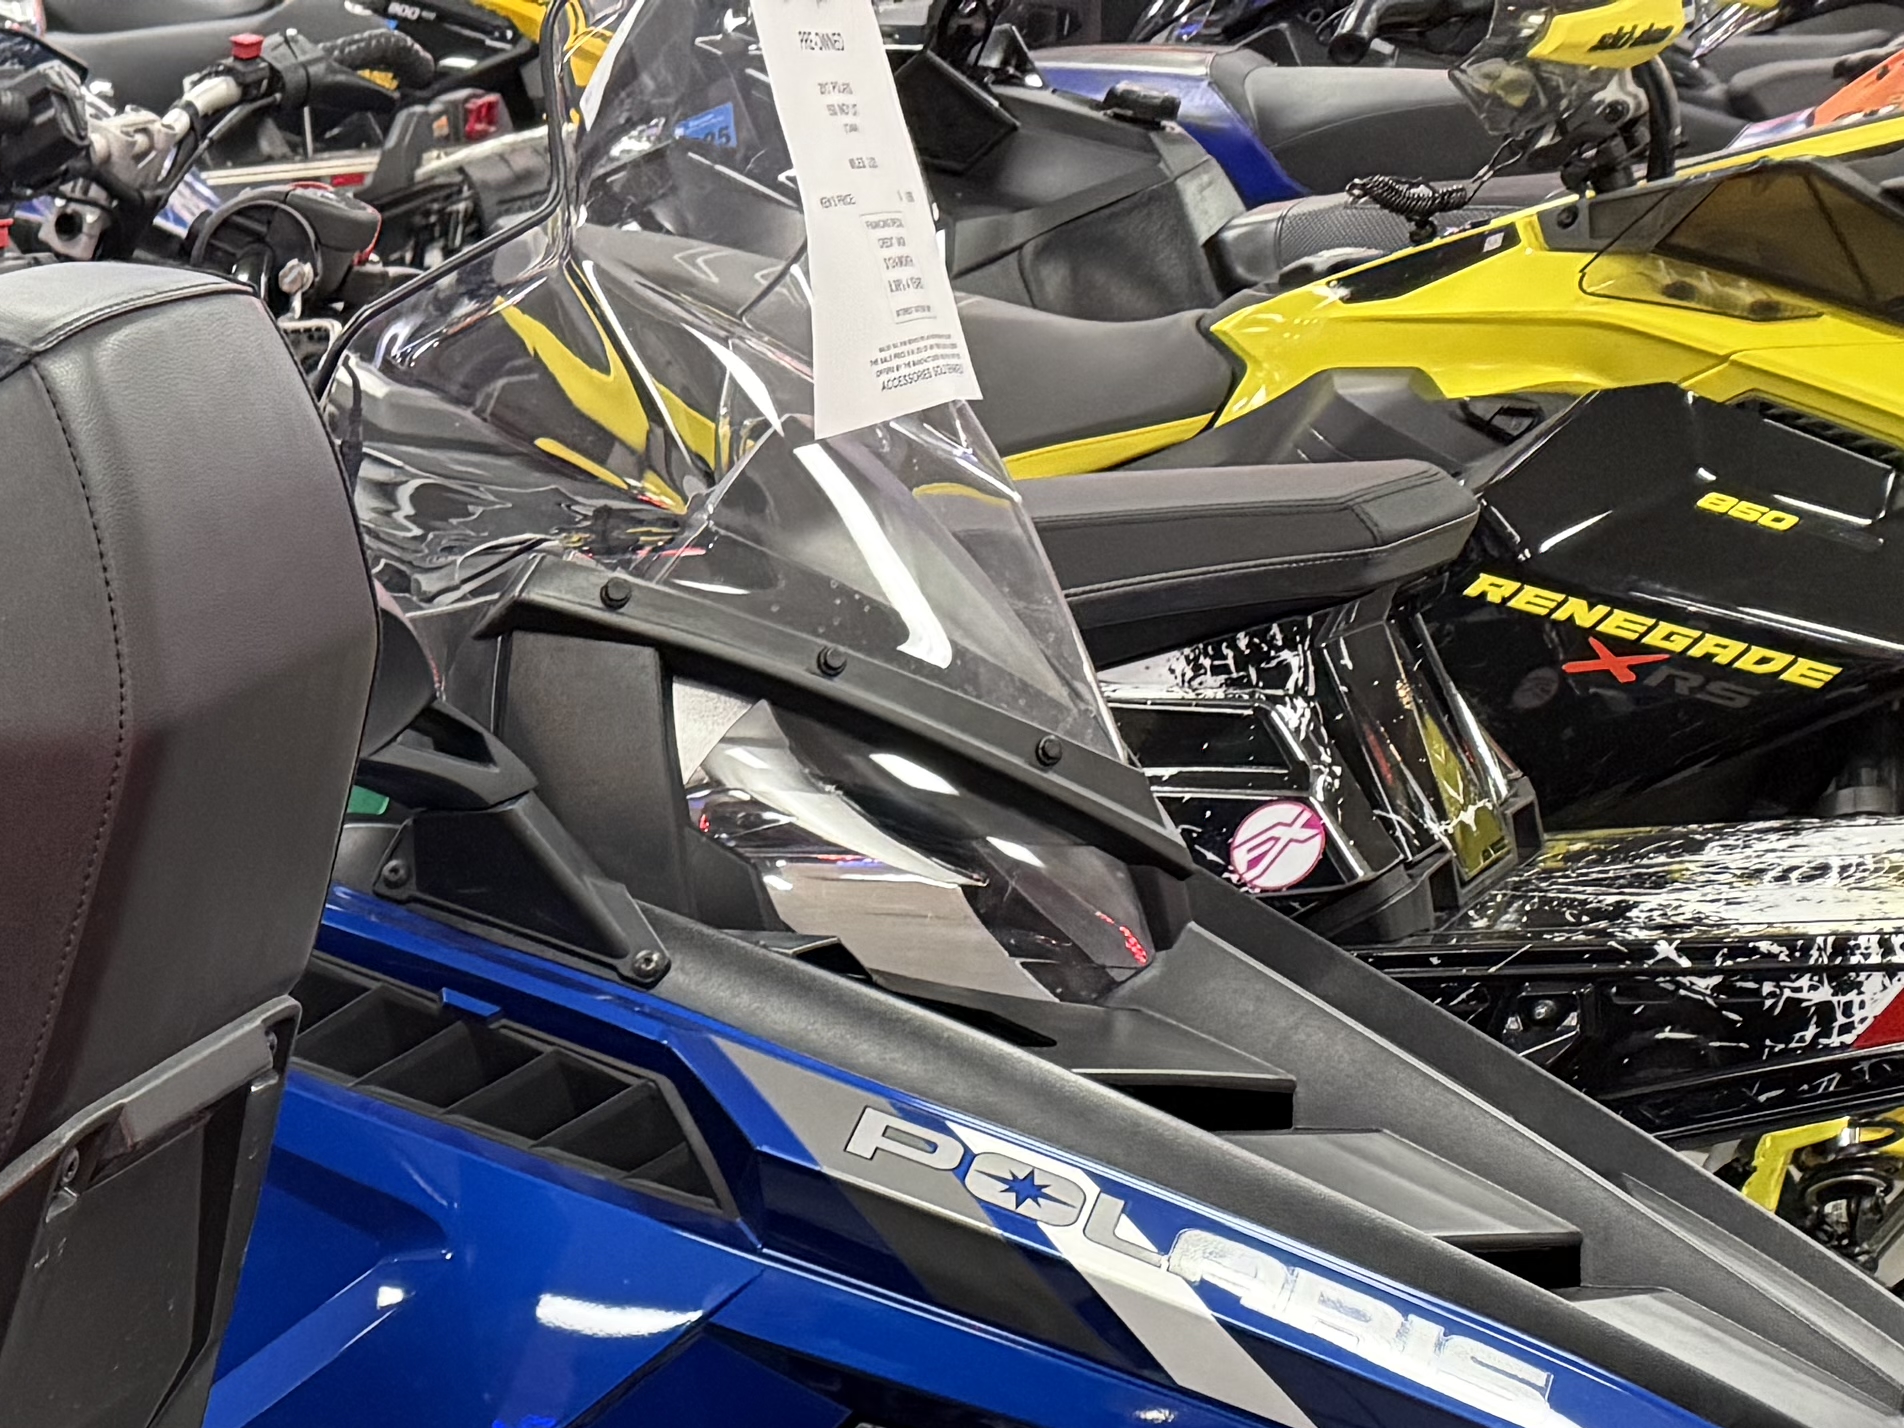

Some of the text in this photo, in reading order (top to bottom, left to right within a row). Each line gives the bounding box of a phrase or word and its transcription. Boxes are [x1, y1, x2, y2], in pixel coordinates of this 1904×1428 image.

[1696, 491, 1800, 532] 850
[1462, 572, 1844, 690] RENEGADE
[843, 1105, 1556, 1411] POLARIS
